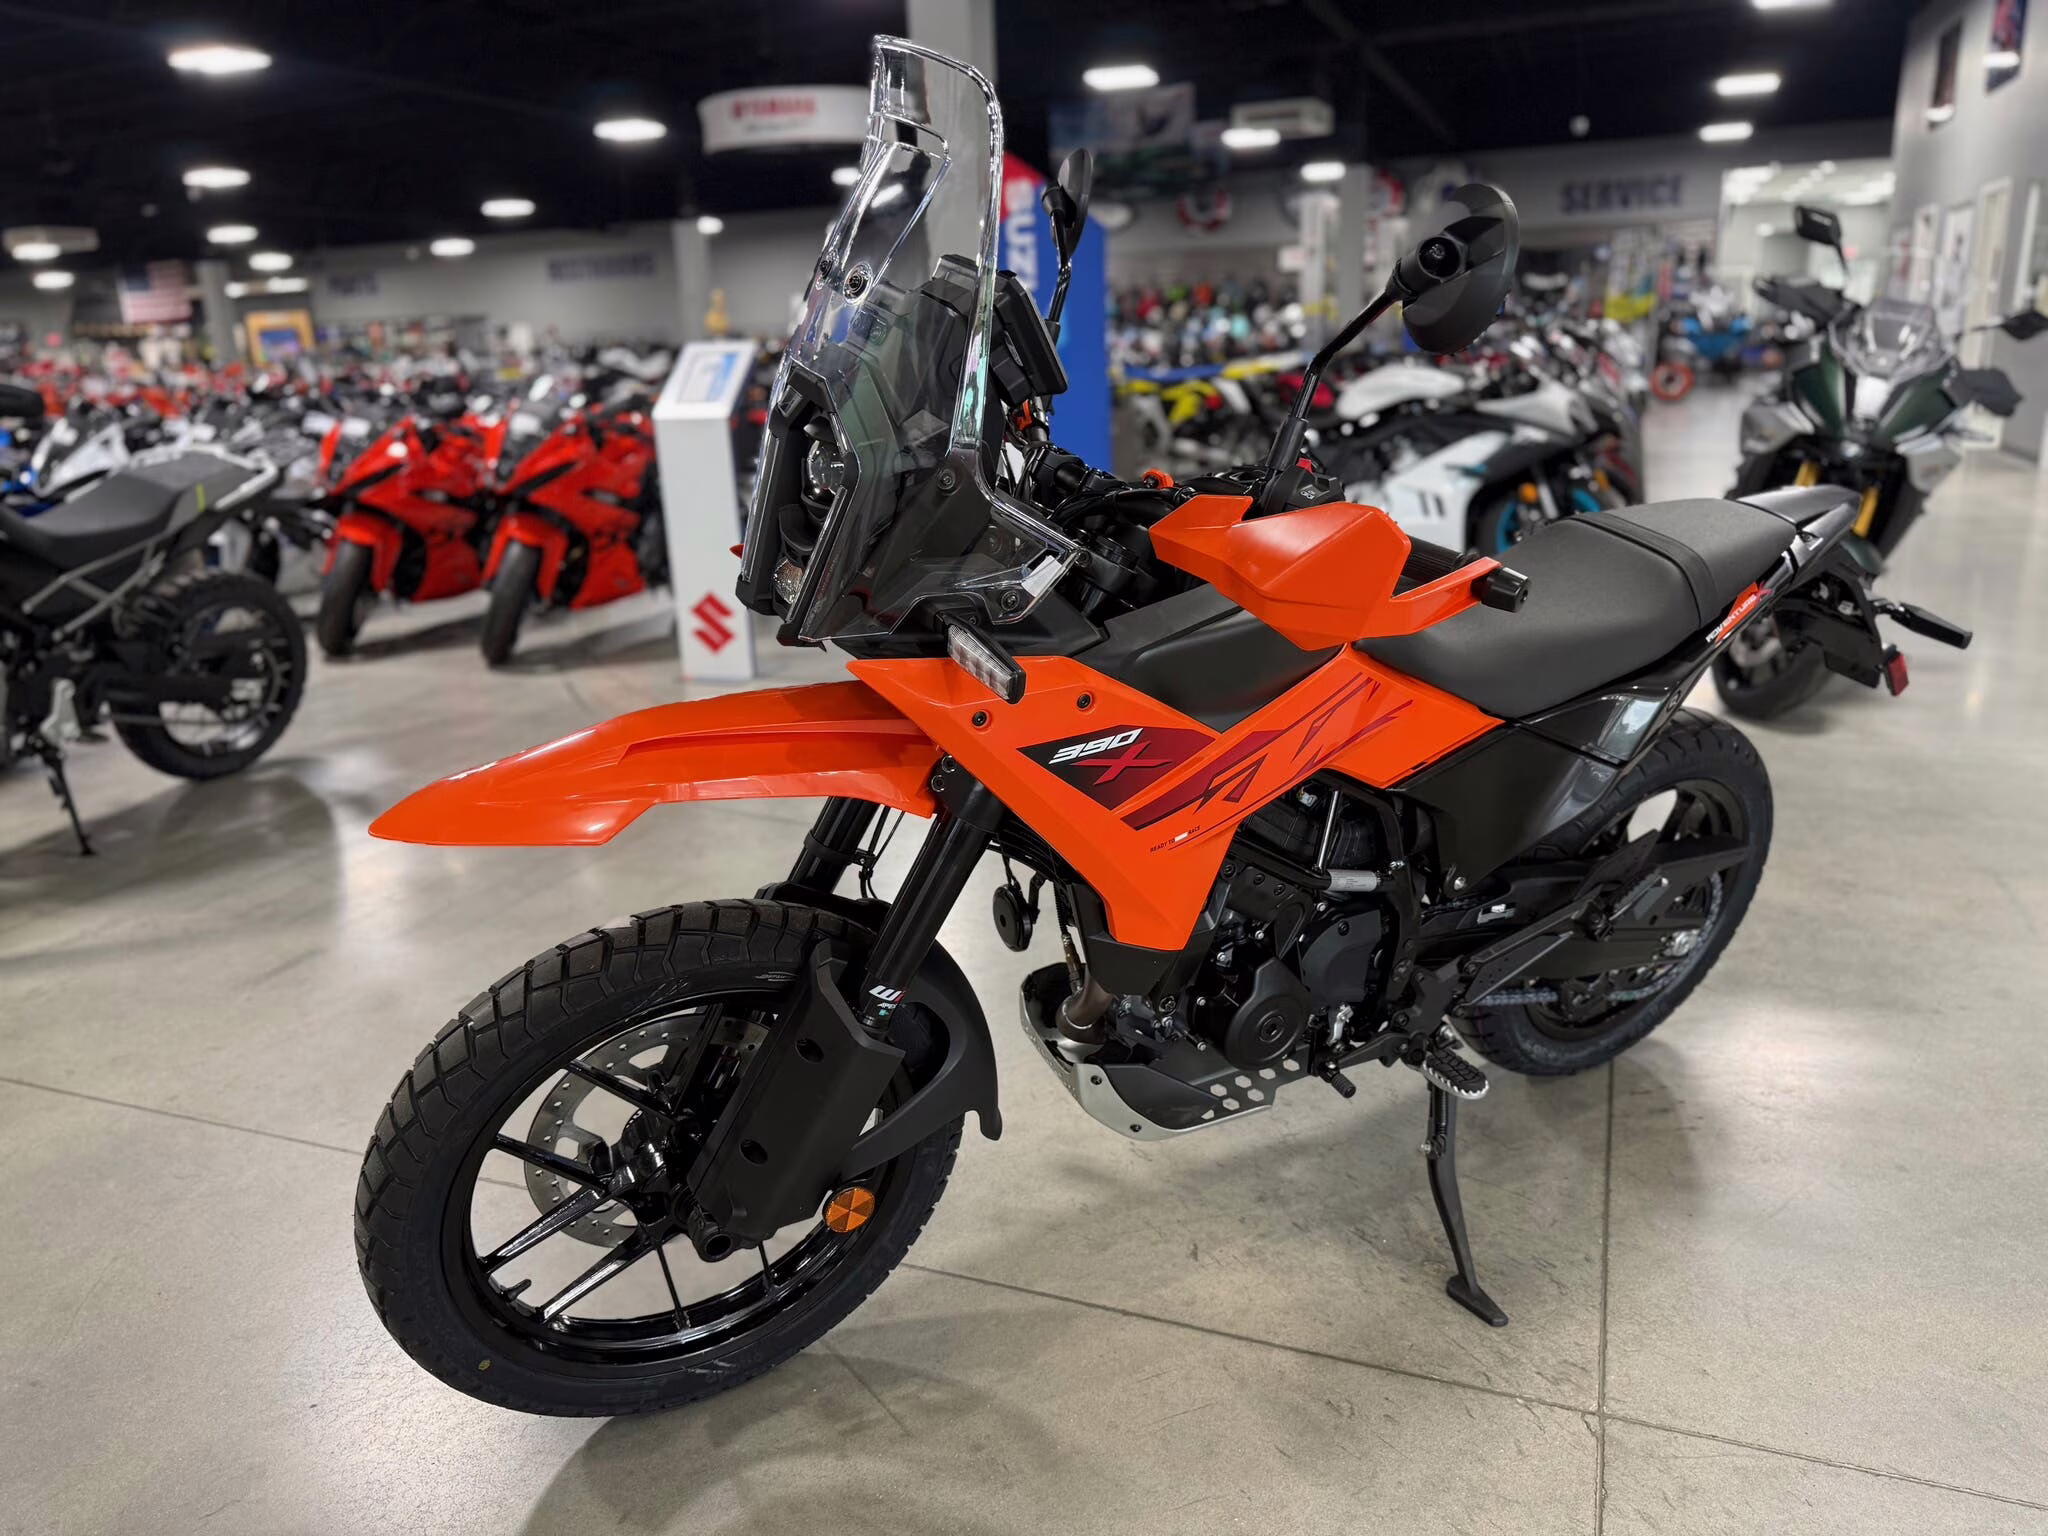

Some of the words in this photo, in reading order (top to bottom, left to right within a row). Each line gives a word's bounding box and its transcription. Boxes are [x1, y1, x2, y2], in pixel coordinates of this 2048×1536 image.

[1561, 175, 1682, 214] SERVICE
[1705, 593, 1757, 643] ADVENTURE
[1048, 727, 1144, 765] 390
[1068, 741, 1173, 786] X
